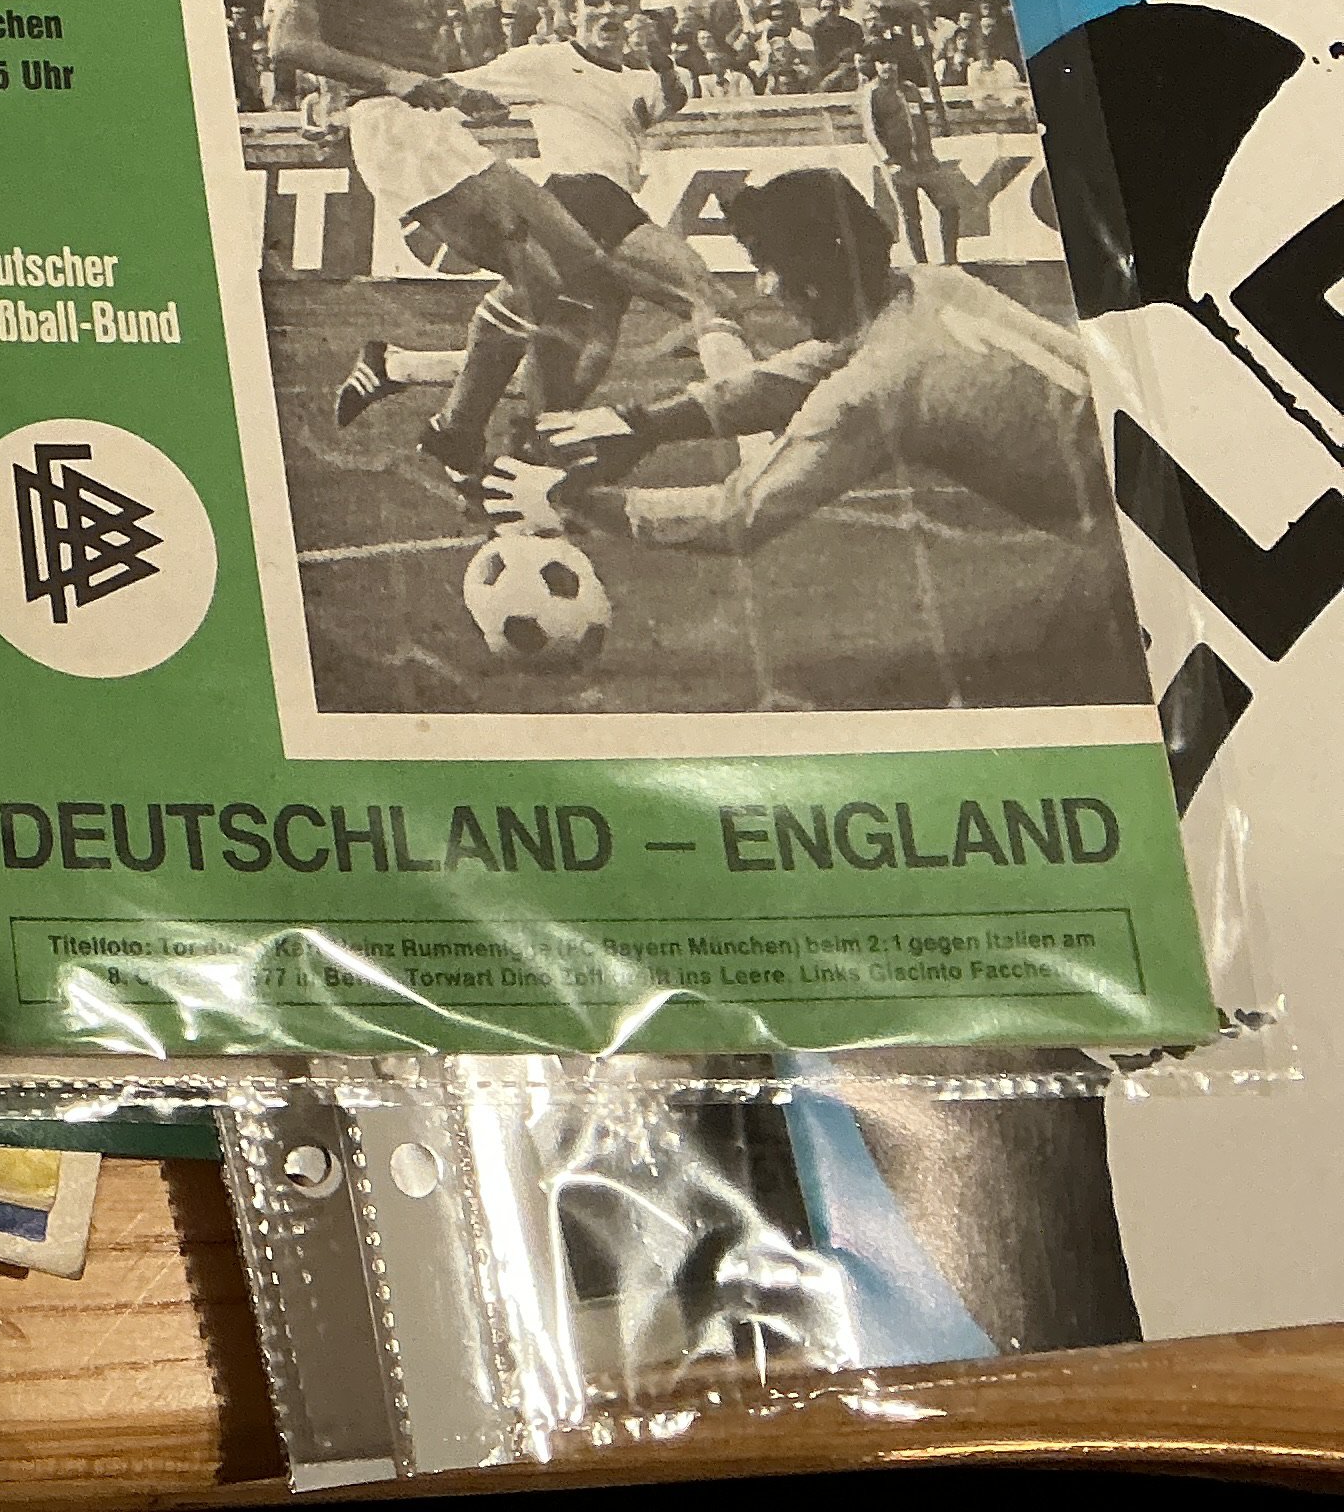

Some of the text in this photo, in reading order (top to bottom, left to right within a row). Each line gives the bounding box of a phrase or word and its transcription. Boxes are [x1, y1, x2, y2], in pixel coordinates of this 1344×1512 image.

[22, 60, 74, 90] Uhr
[2, 800, 612, 874] DEUTSCHLAND
[721, 795, 1120, 871] ENGLAND
[49, 935, 153, 958] Titelfoto:
[911, 936, 979, 956] gegen
[985, 930, 1055, 951] Italien
[1062, 932, 1097, 949] am
[800, 963, 861, 985] Links
